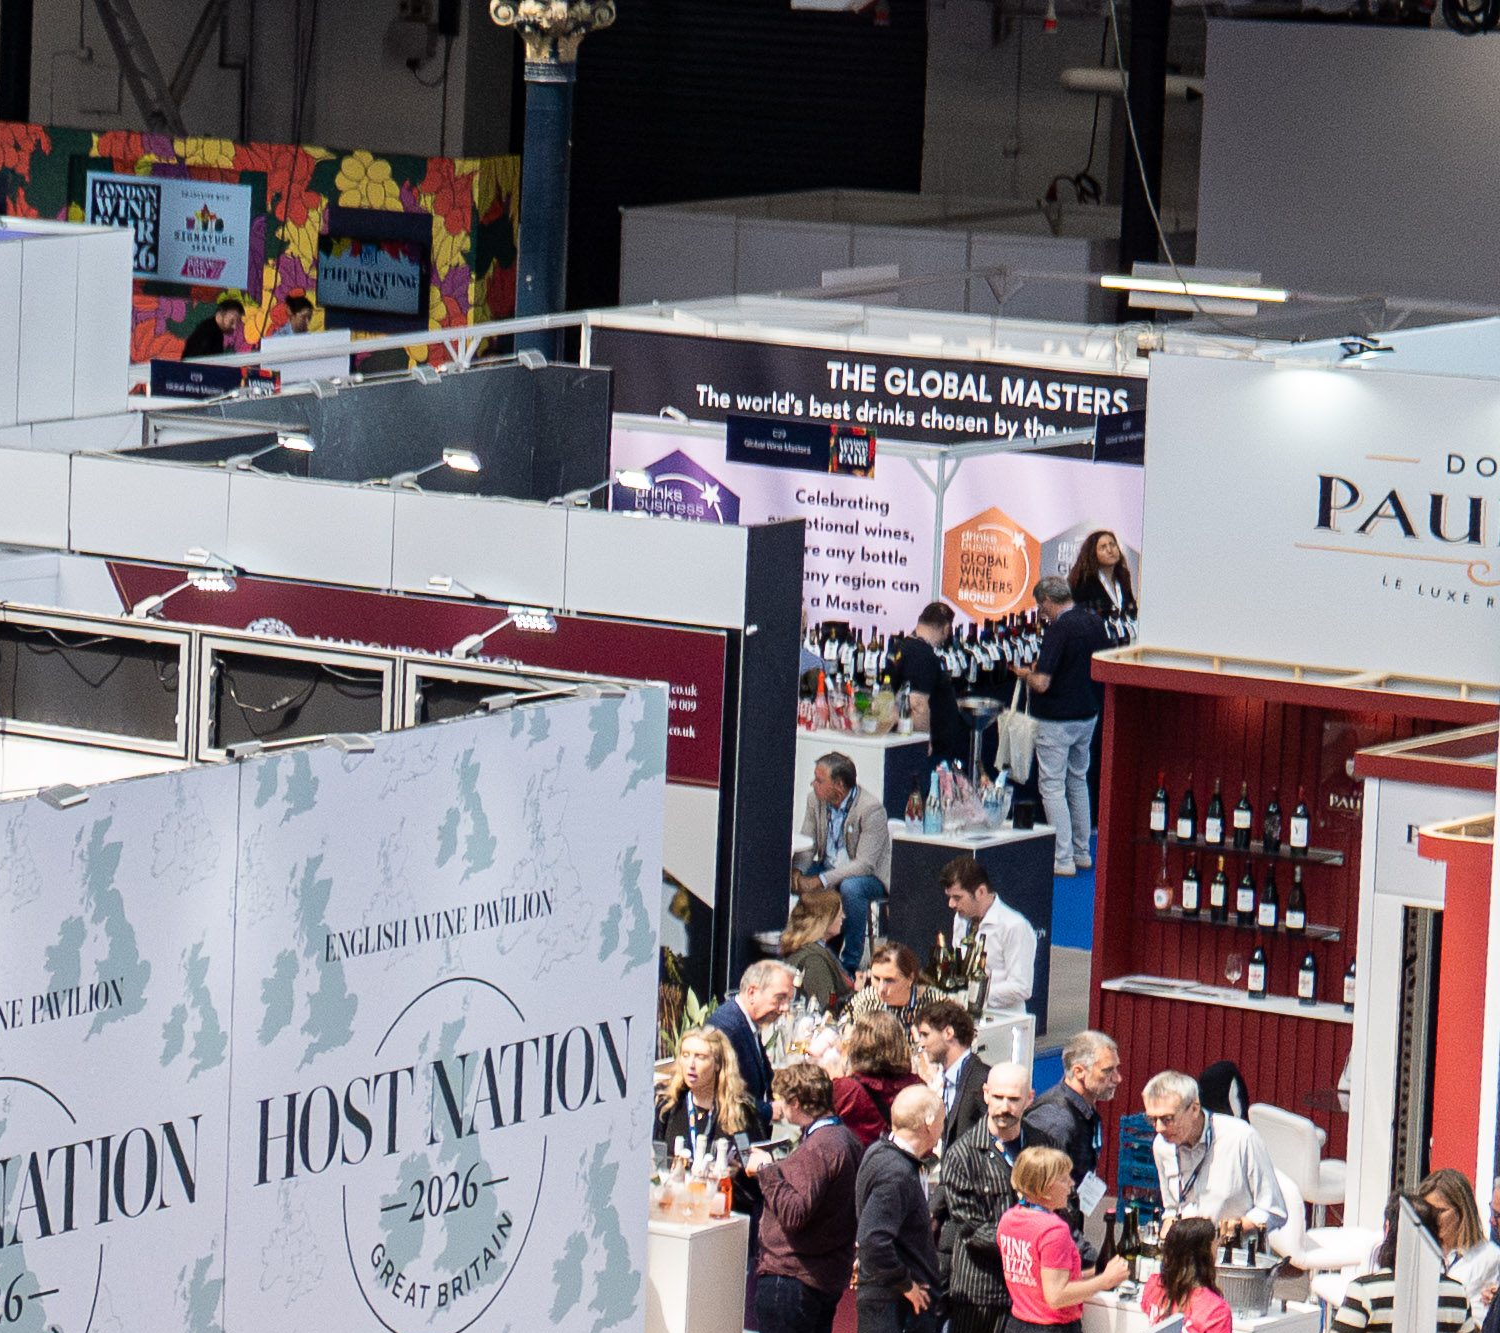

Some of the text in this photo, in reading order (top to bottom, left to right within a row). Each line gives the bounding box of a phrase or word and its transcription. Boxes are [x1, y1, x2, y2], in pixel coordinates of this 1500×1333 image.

[827, 360, 1130, 416] THE GLOBAL MASTERS
[696, 384, 730, 409] The
[736, 390, 804, 416] world's
[809, 394, 851, 420] best
[856, 400, 915, 428] drinks
[921, 406, 988, 434] chosen
[994, 410, 1018, 441] by
[795, 489, 889, 517] Celebrating
[826, 546, 908, 567] any bottle
[864, 522, 915, 543] wines,
[825, 595, 888, 616] Master.
[835, 571, 887, 591] region
[892, 580, 921, 594] can
[324, 887, 555, 963] ENGLISH WINE PAVILION
[29, 975, 125, 1027] PAVILION
[253, 1015, 634, 1187] HOST NATION
[408, 1176, 480, 1224] 2026
[369, 1210, 515, 1312] GREAT BRITAIN
[1000, 1233, 1032, 1263] PINK
